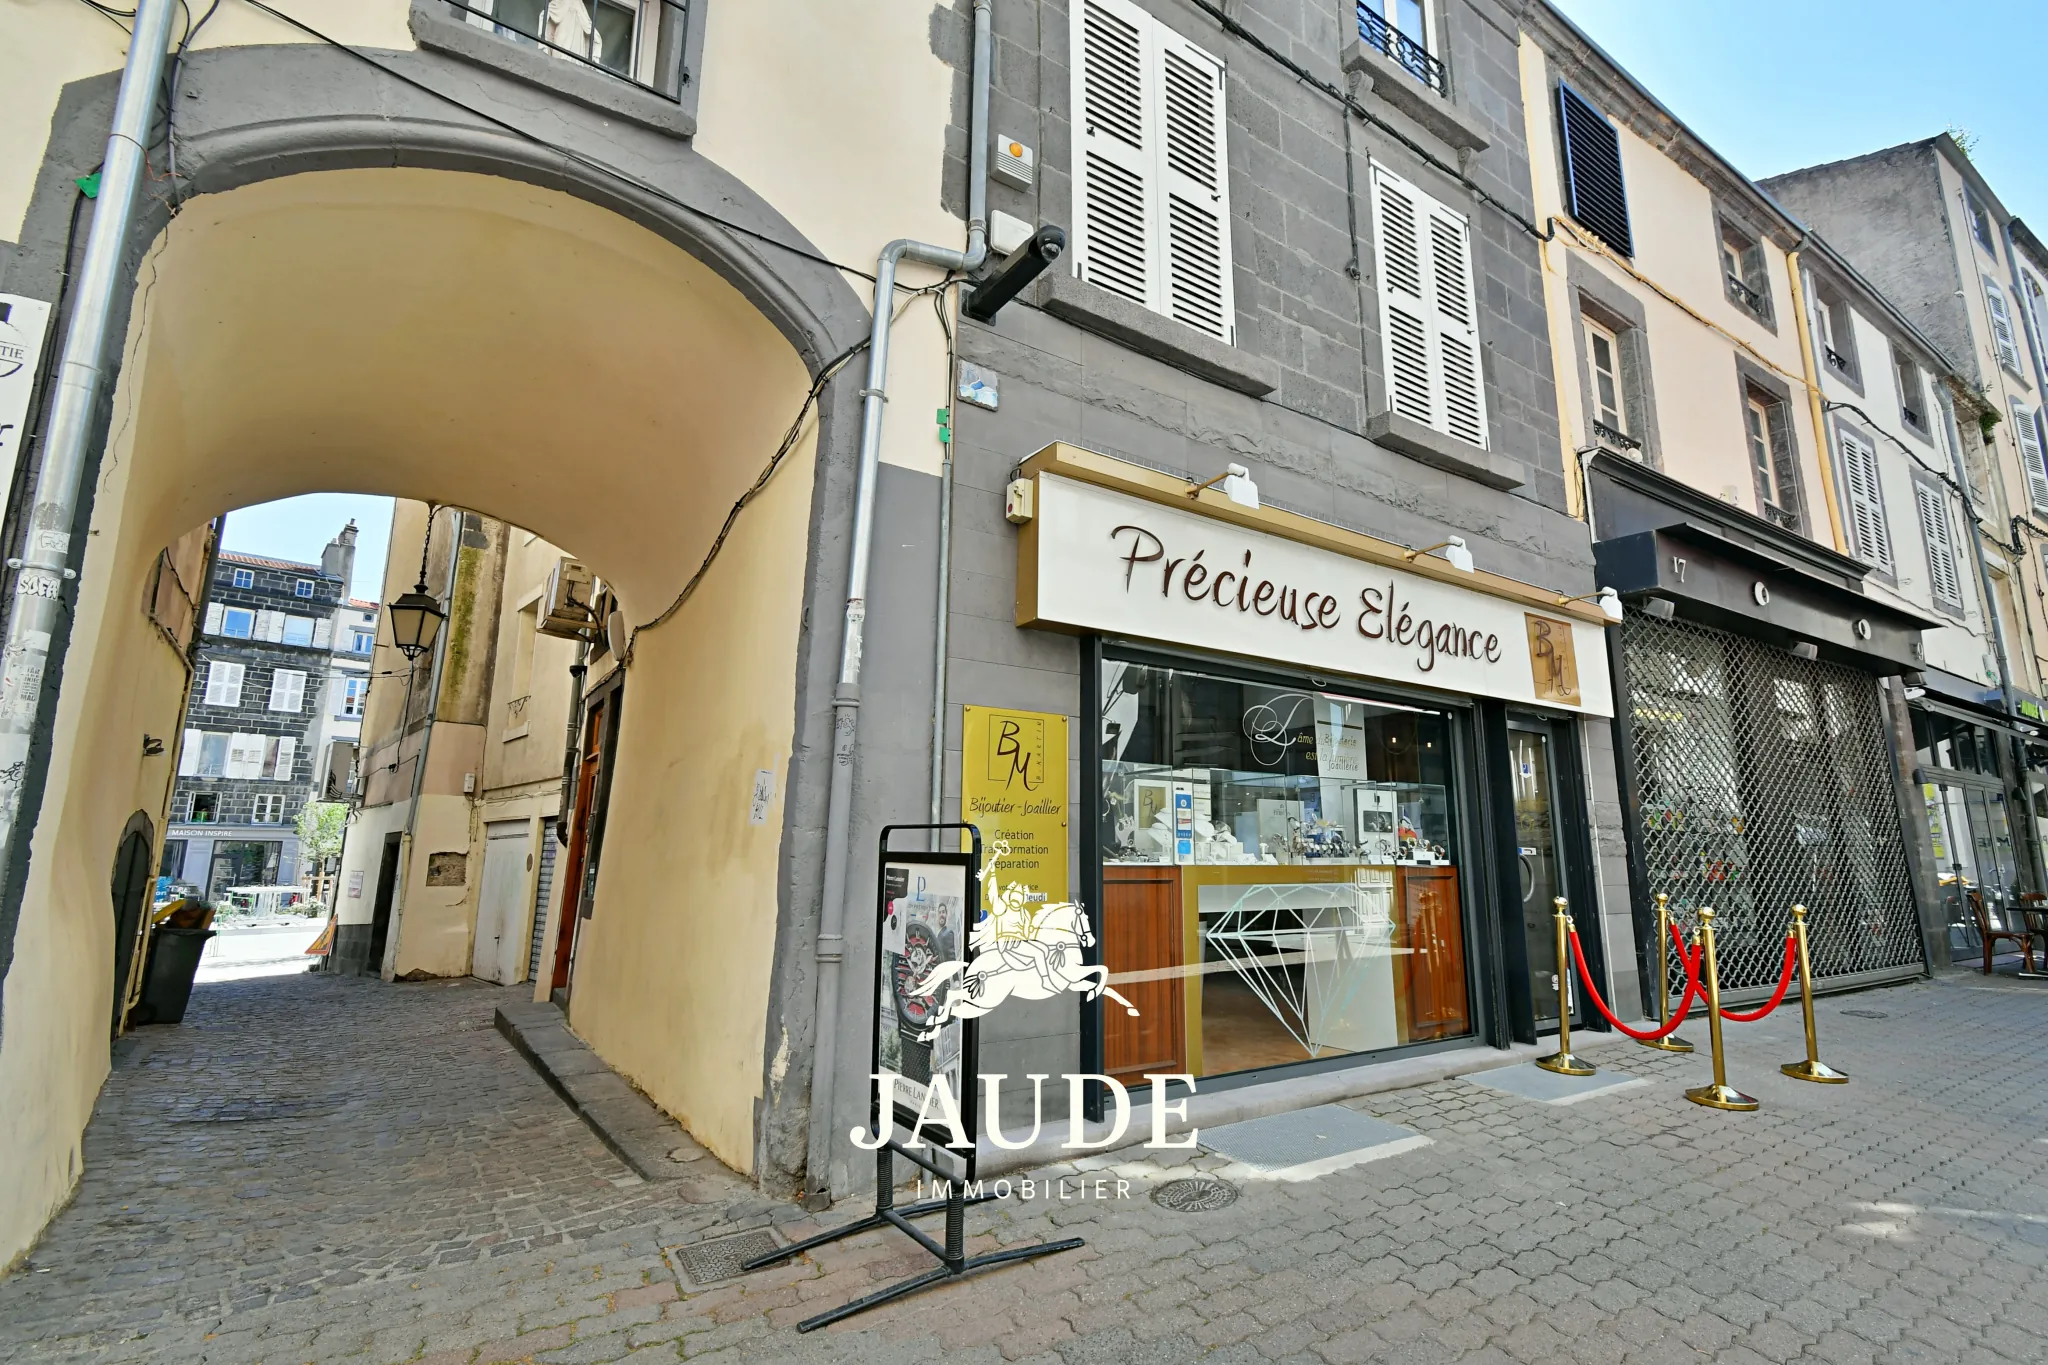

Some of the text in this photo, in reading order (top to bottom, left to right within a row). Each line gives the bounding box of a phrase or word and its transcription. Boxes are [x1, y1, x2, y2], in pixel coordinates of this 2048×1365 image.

[1673, 556, 1687, 583] 17
[1110, 525, 1341, 631] Précieuse
[1357, 580, 1502, 672] Elégance
[994, 829, 1034, 840] Création
[913, 1086, 939, 1110] LANIER
